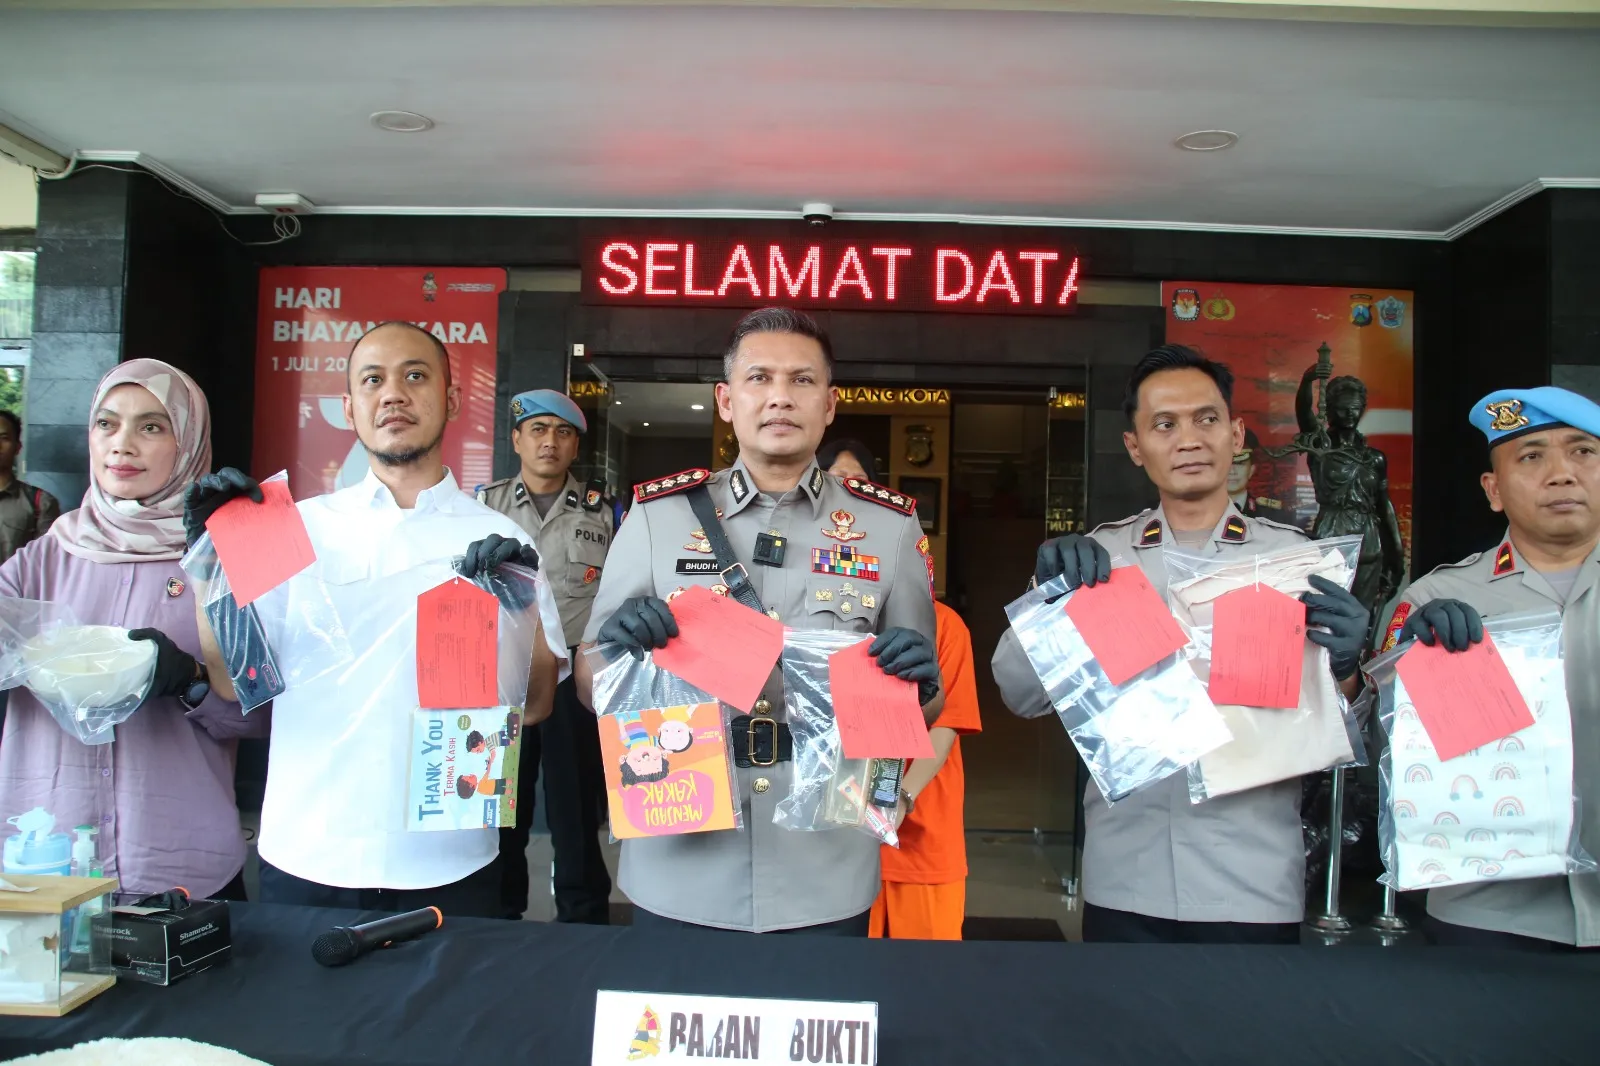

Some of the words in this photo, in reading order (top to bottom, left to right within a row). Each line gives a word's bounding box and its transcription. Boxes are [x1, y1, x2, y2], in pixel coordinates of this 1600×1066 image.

[599, 242, 912, 299] SELAMAT
[275, 287, 341, 309] HARI
[273, 320, 488, 344] BHAYAARA
[272, 357, 279, 371] 1
[284, 357, 319, 372] JULI
[324, 357, 348, 372] 20
[900, 388, 950, 403] KOTA
[575, 529, 606, 546] POLRI
[421, 719, 444, 756] YOU
[445, 737, 457, 763] KASIH
[418, 762, 444, 821] THANK
[444, 765, 456, 796] TERIMA
[637, 773, 698, 806] KAKAK
[645, 803, 703, 827] MENJADI
[180, 922, 213, 940] Shamrock
[789, 1018, 870, 1065] BUKTI
